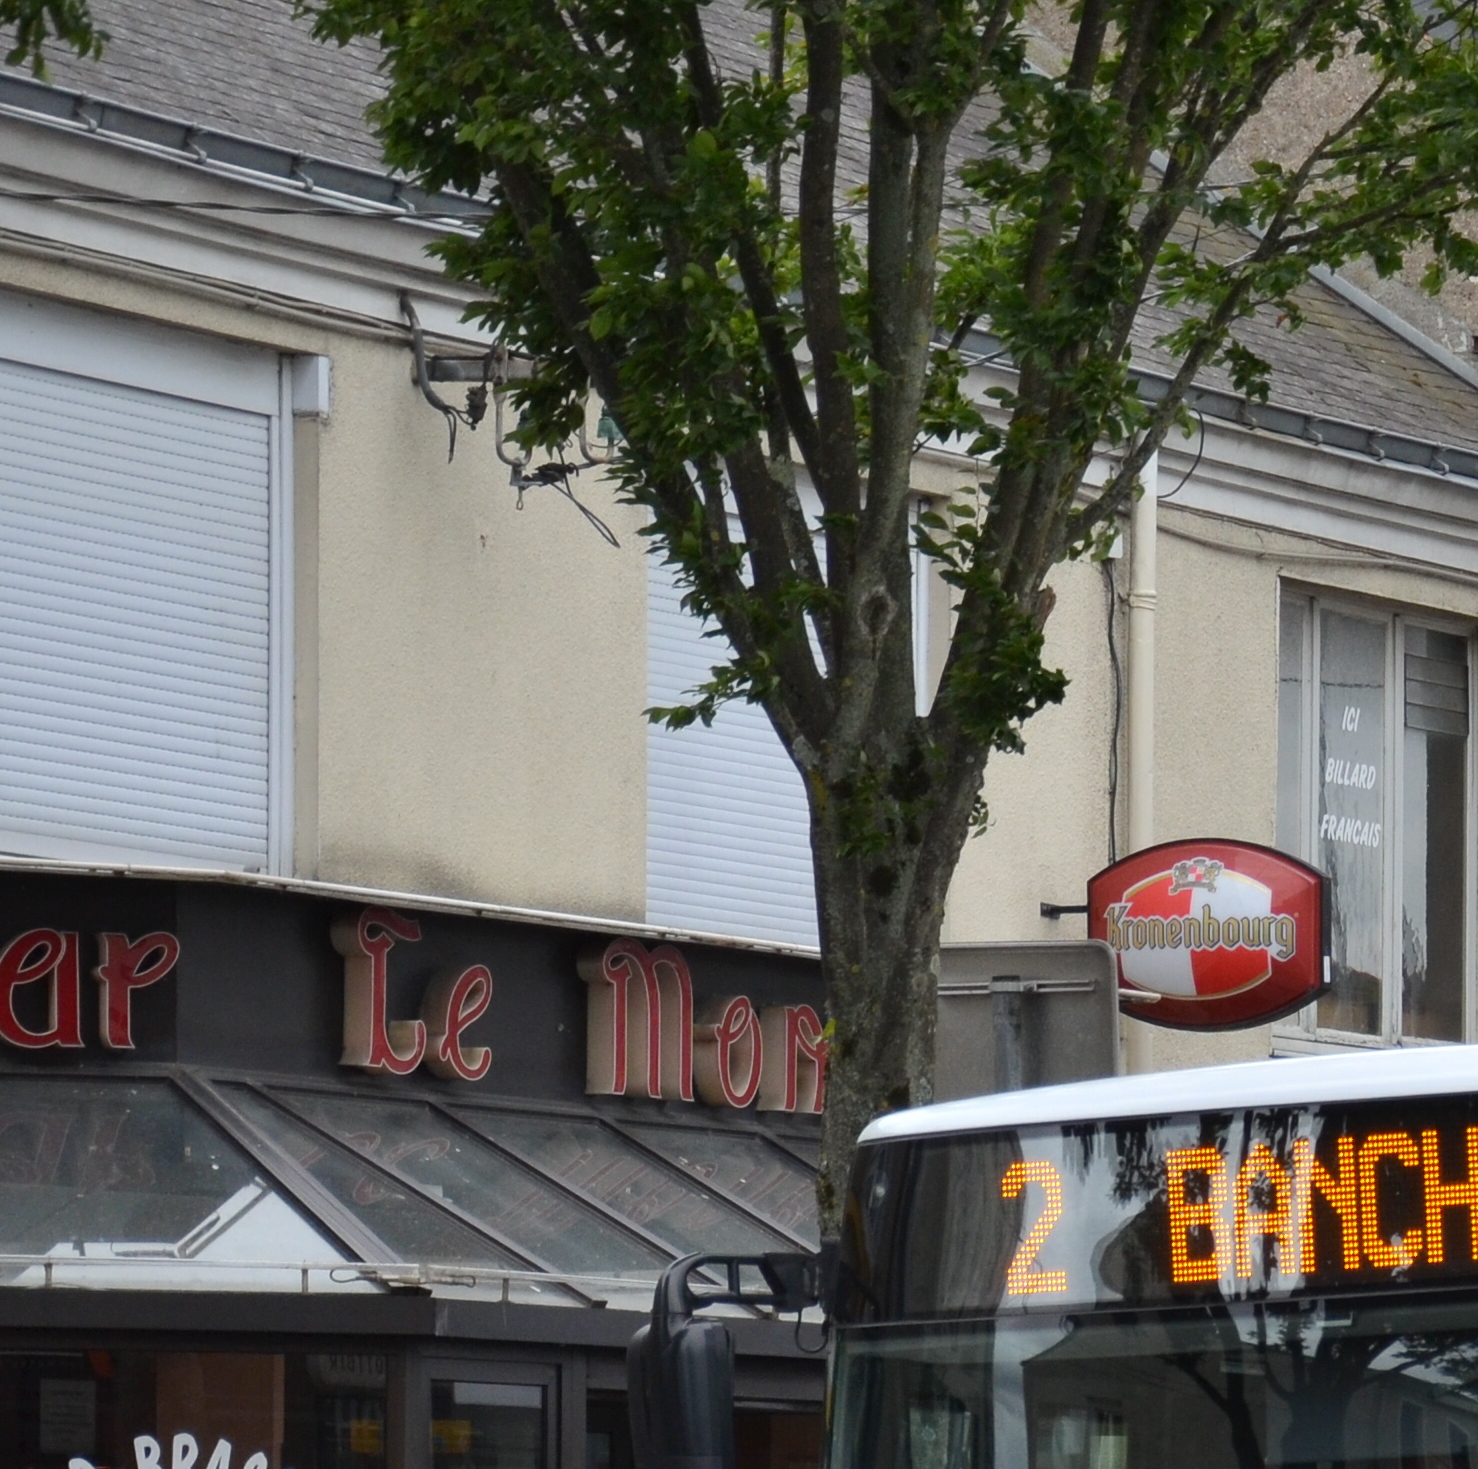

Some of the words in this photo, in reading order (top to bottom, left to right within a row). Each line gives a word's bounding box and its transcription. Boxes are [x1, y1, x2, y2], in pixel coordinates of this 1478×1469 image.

[1342, 705, 1361, 733] ICI
[1325, 757, 1377, 790] BILLARD
[1104, 902, 1296, 962] Kronenbourg
[357, 905, 493, 1082] Le
[1001, 1159, 1069, 1297] 2
